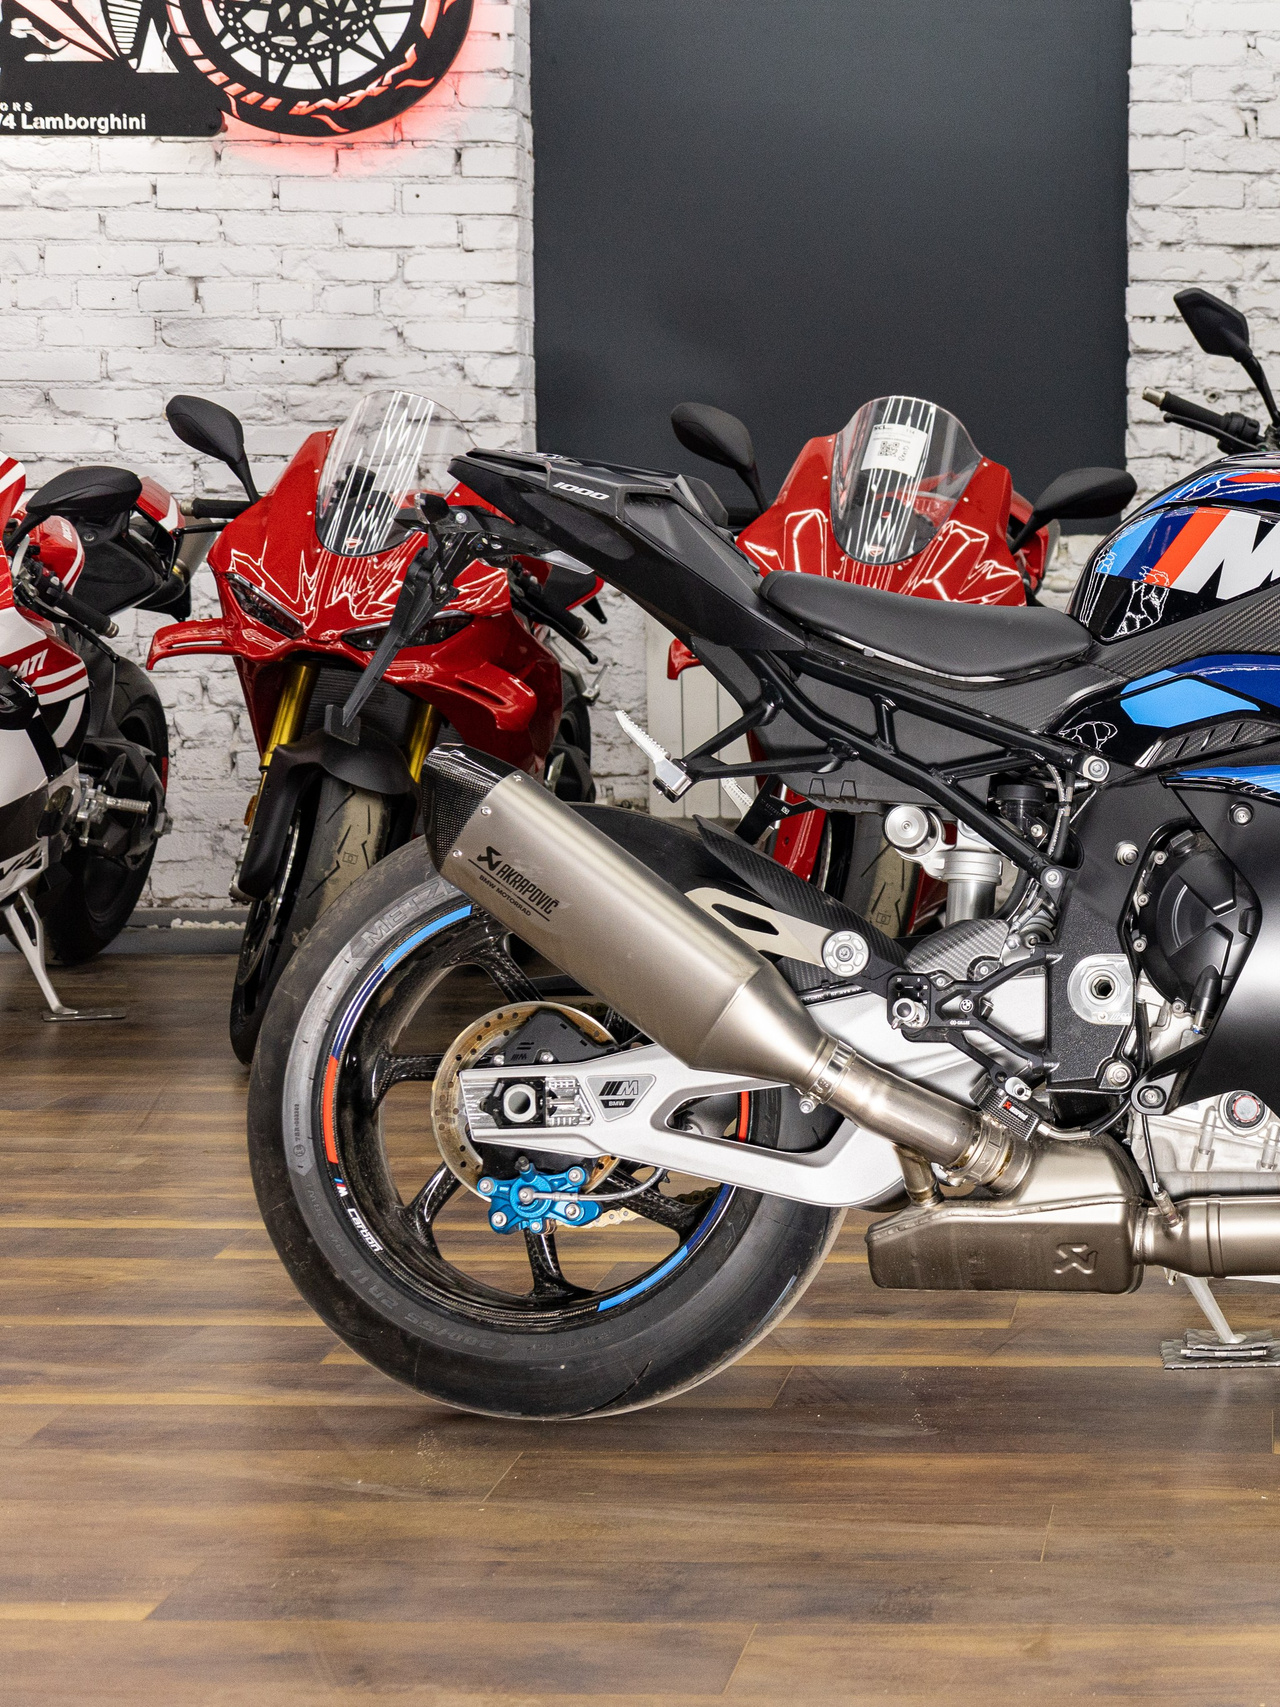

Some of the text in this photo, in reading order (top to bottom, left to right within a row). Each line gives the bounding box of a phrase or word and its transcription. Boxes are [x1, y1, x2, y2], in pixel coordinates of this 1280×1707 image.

[21, 113, 146, 134] Lamborghini
[552, 481, 610, 501] 1000
[478, 873, 532, 917] BMW MOTORRAD
